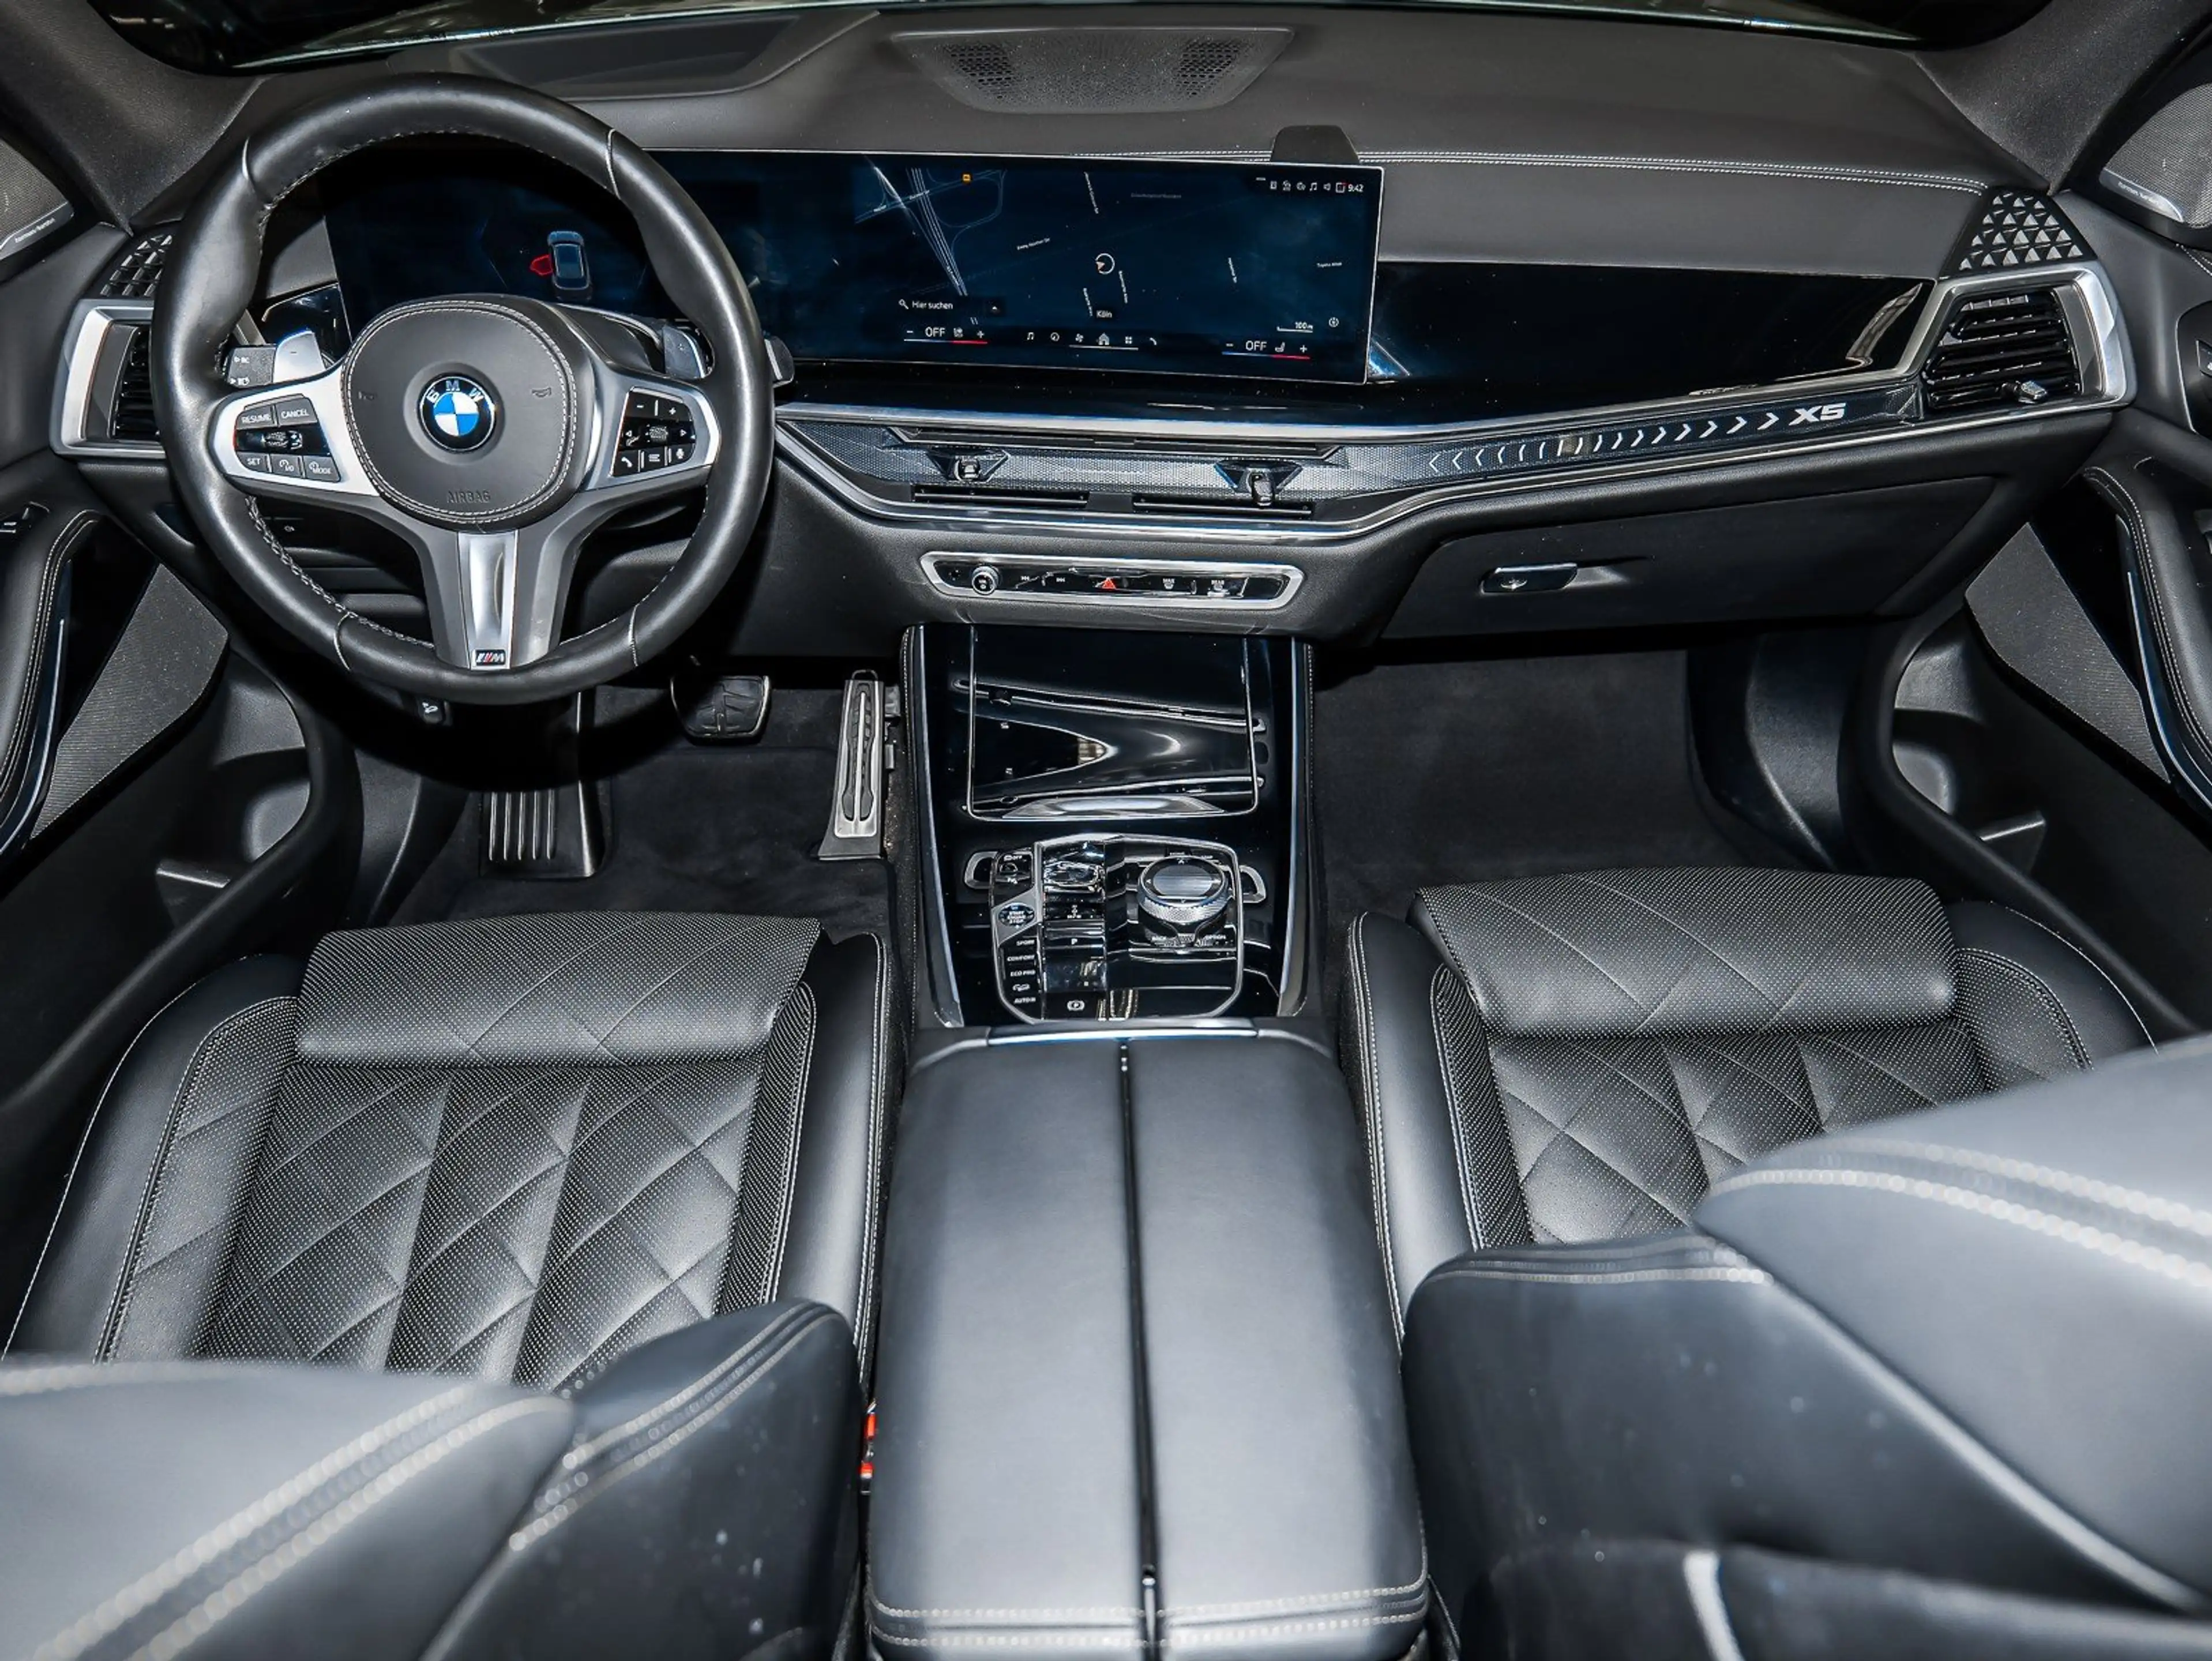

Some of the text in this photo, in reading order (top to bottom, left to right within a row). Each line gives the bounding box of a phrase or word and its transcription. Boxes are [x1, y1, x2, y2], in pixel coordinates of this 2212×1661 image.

[912, 300, 953, 310] Hier suchen
[925, 326, 946, 337] OFF
[1245, 340, 1267, 351] OFF
[426, 380, 485, 403] BMW
[242, 414, 272, 423] RESUME
[281, 408, 309, 419] CANCEL
[1789, 403, 1846, 426] X5
[247, 458, 261, 466] SET
[312, 467, 332, 475] MODE
[446, 489, 491, 503] AIRBAG
